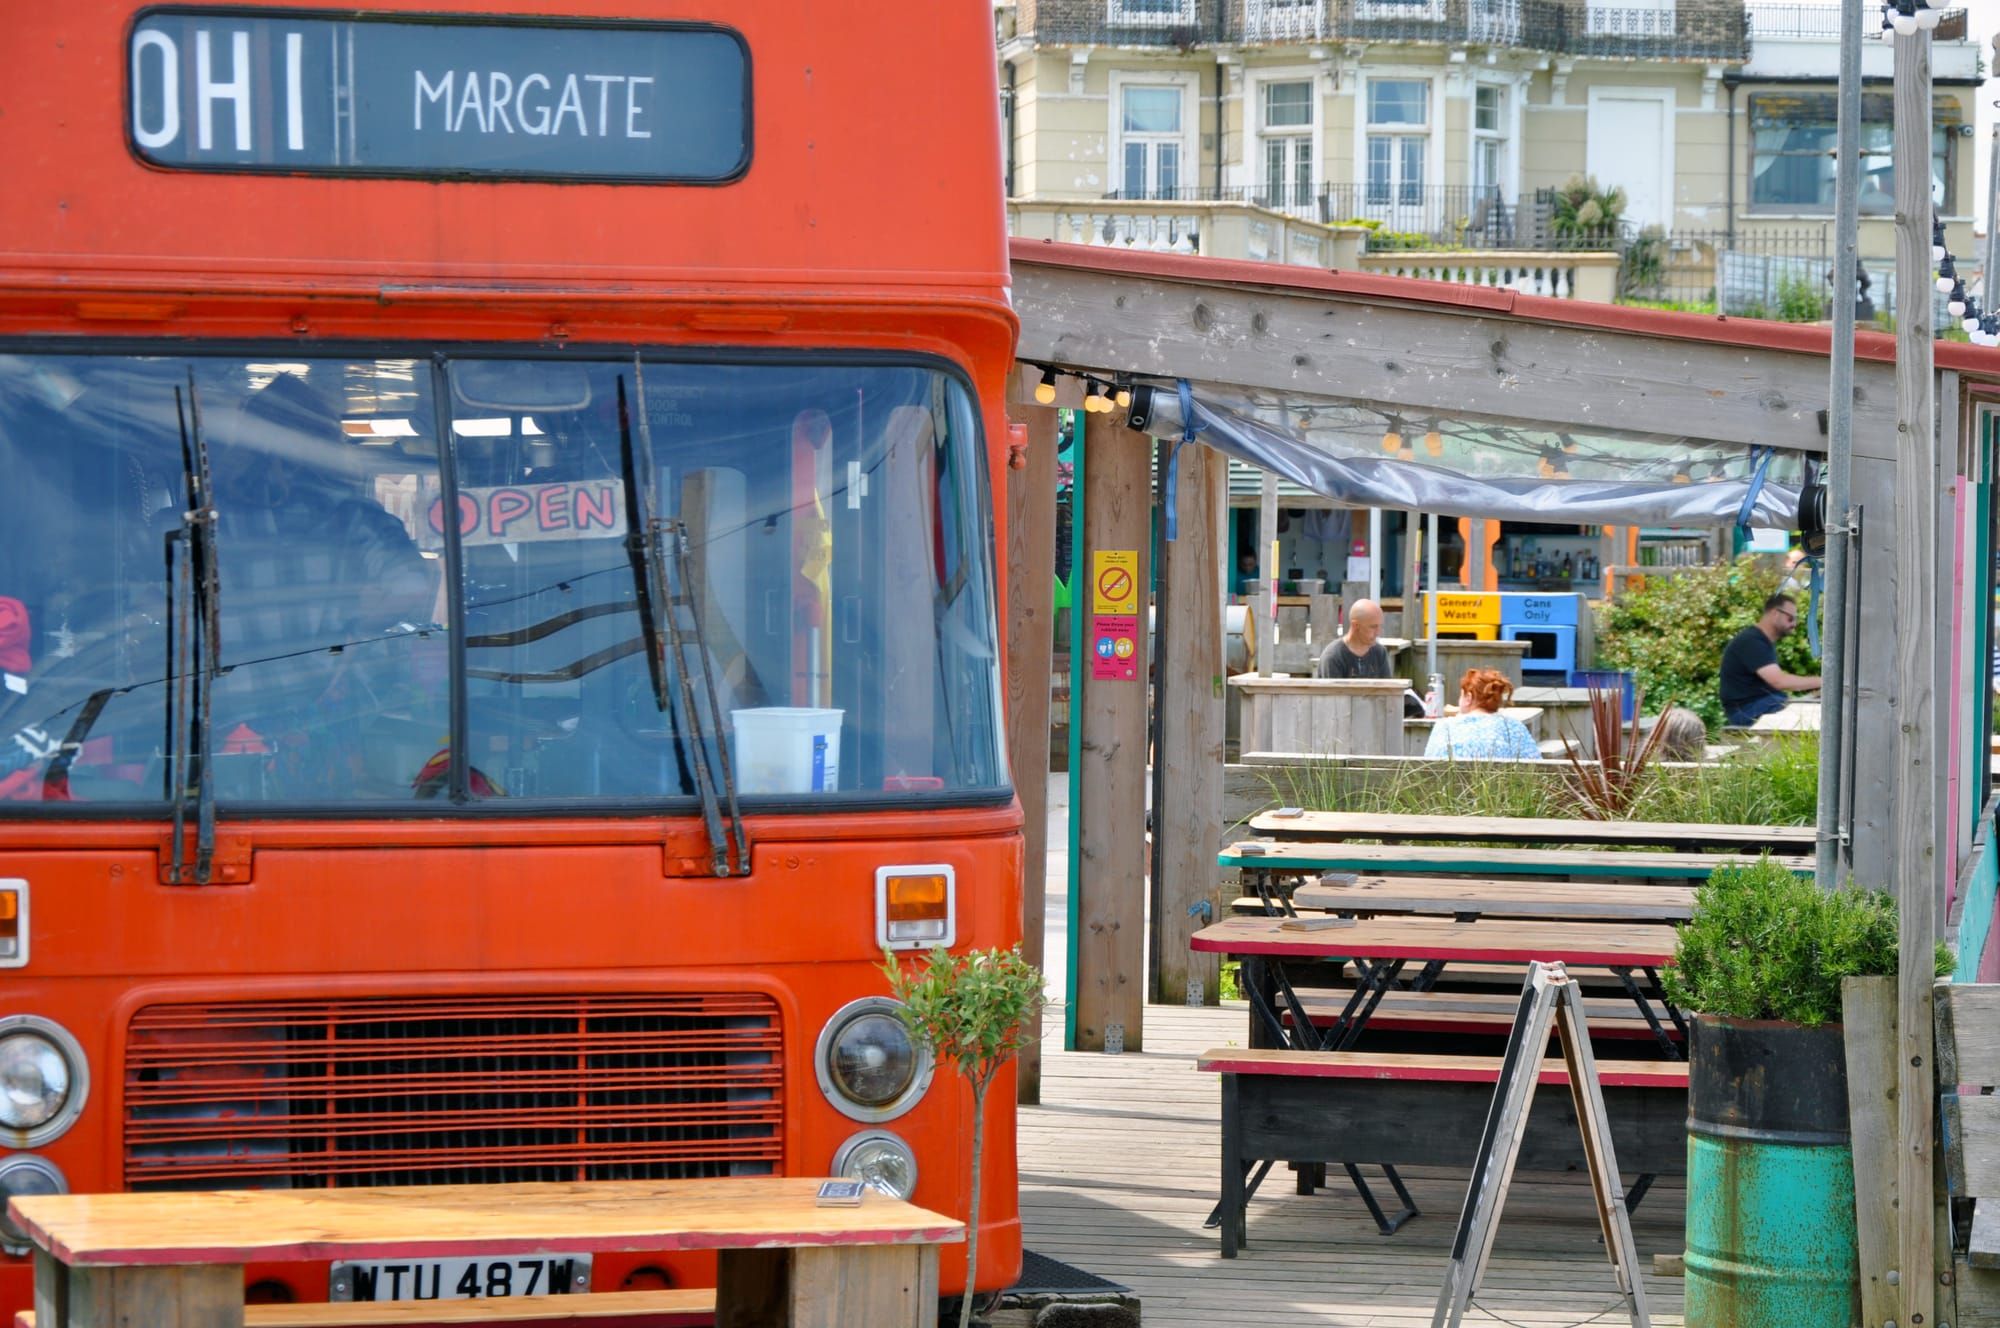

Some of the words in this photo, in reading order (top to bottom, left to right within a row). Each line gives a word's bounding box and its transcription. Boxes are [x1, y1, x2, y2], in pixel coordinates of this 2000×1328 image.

[414, 70, 655, 139] MARGATE
[427, 484, 616, 537] OPEN
[1439, 597, 1483, 608] General
[1524, 598, 1552, 608] Cans
[1444, 610, 1478, 620] Waste
[1524, 610, 1551, 622] Only
[352, 1263, 442, 1301] WTU
[456, 1258, 575, 1299] 487W
